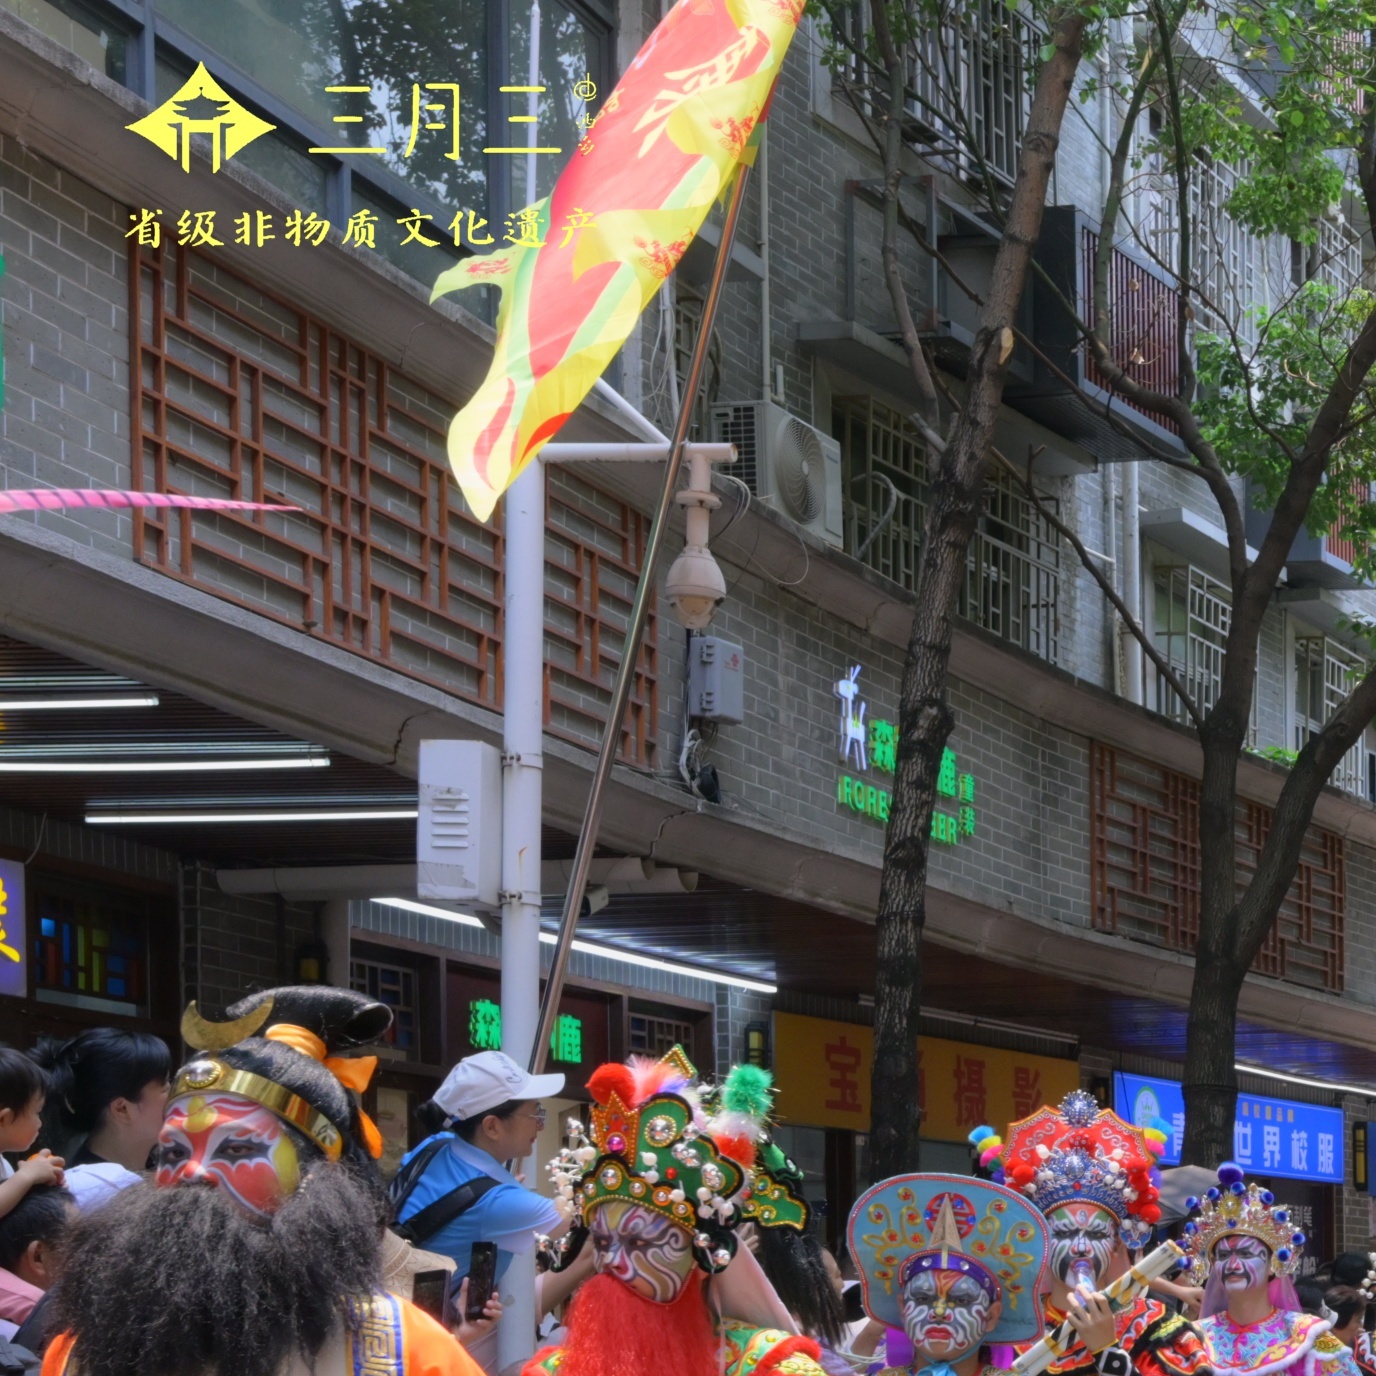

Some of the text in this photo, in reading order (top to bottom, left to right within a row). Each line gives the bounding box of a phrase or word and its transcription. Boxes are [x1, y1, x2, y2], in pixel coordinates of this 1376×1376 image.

[868, 719, 957, 796] 森鹿
[470, 999, 582, 1065] 森鹿
[824, 1036, 1044, 1128] 宝摄影
[1172, 1112, 1335, 1175] 青世界校服
